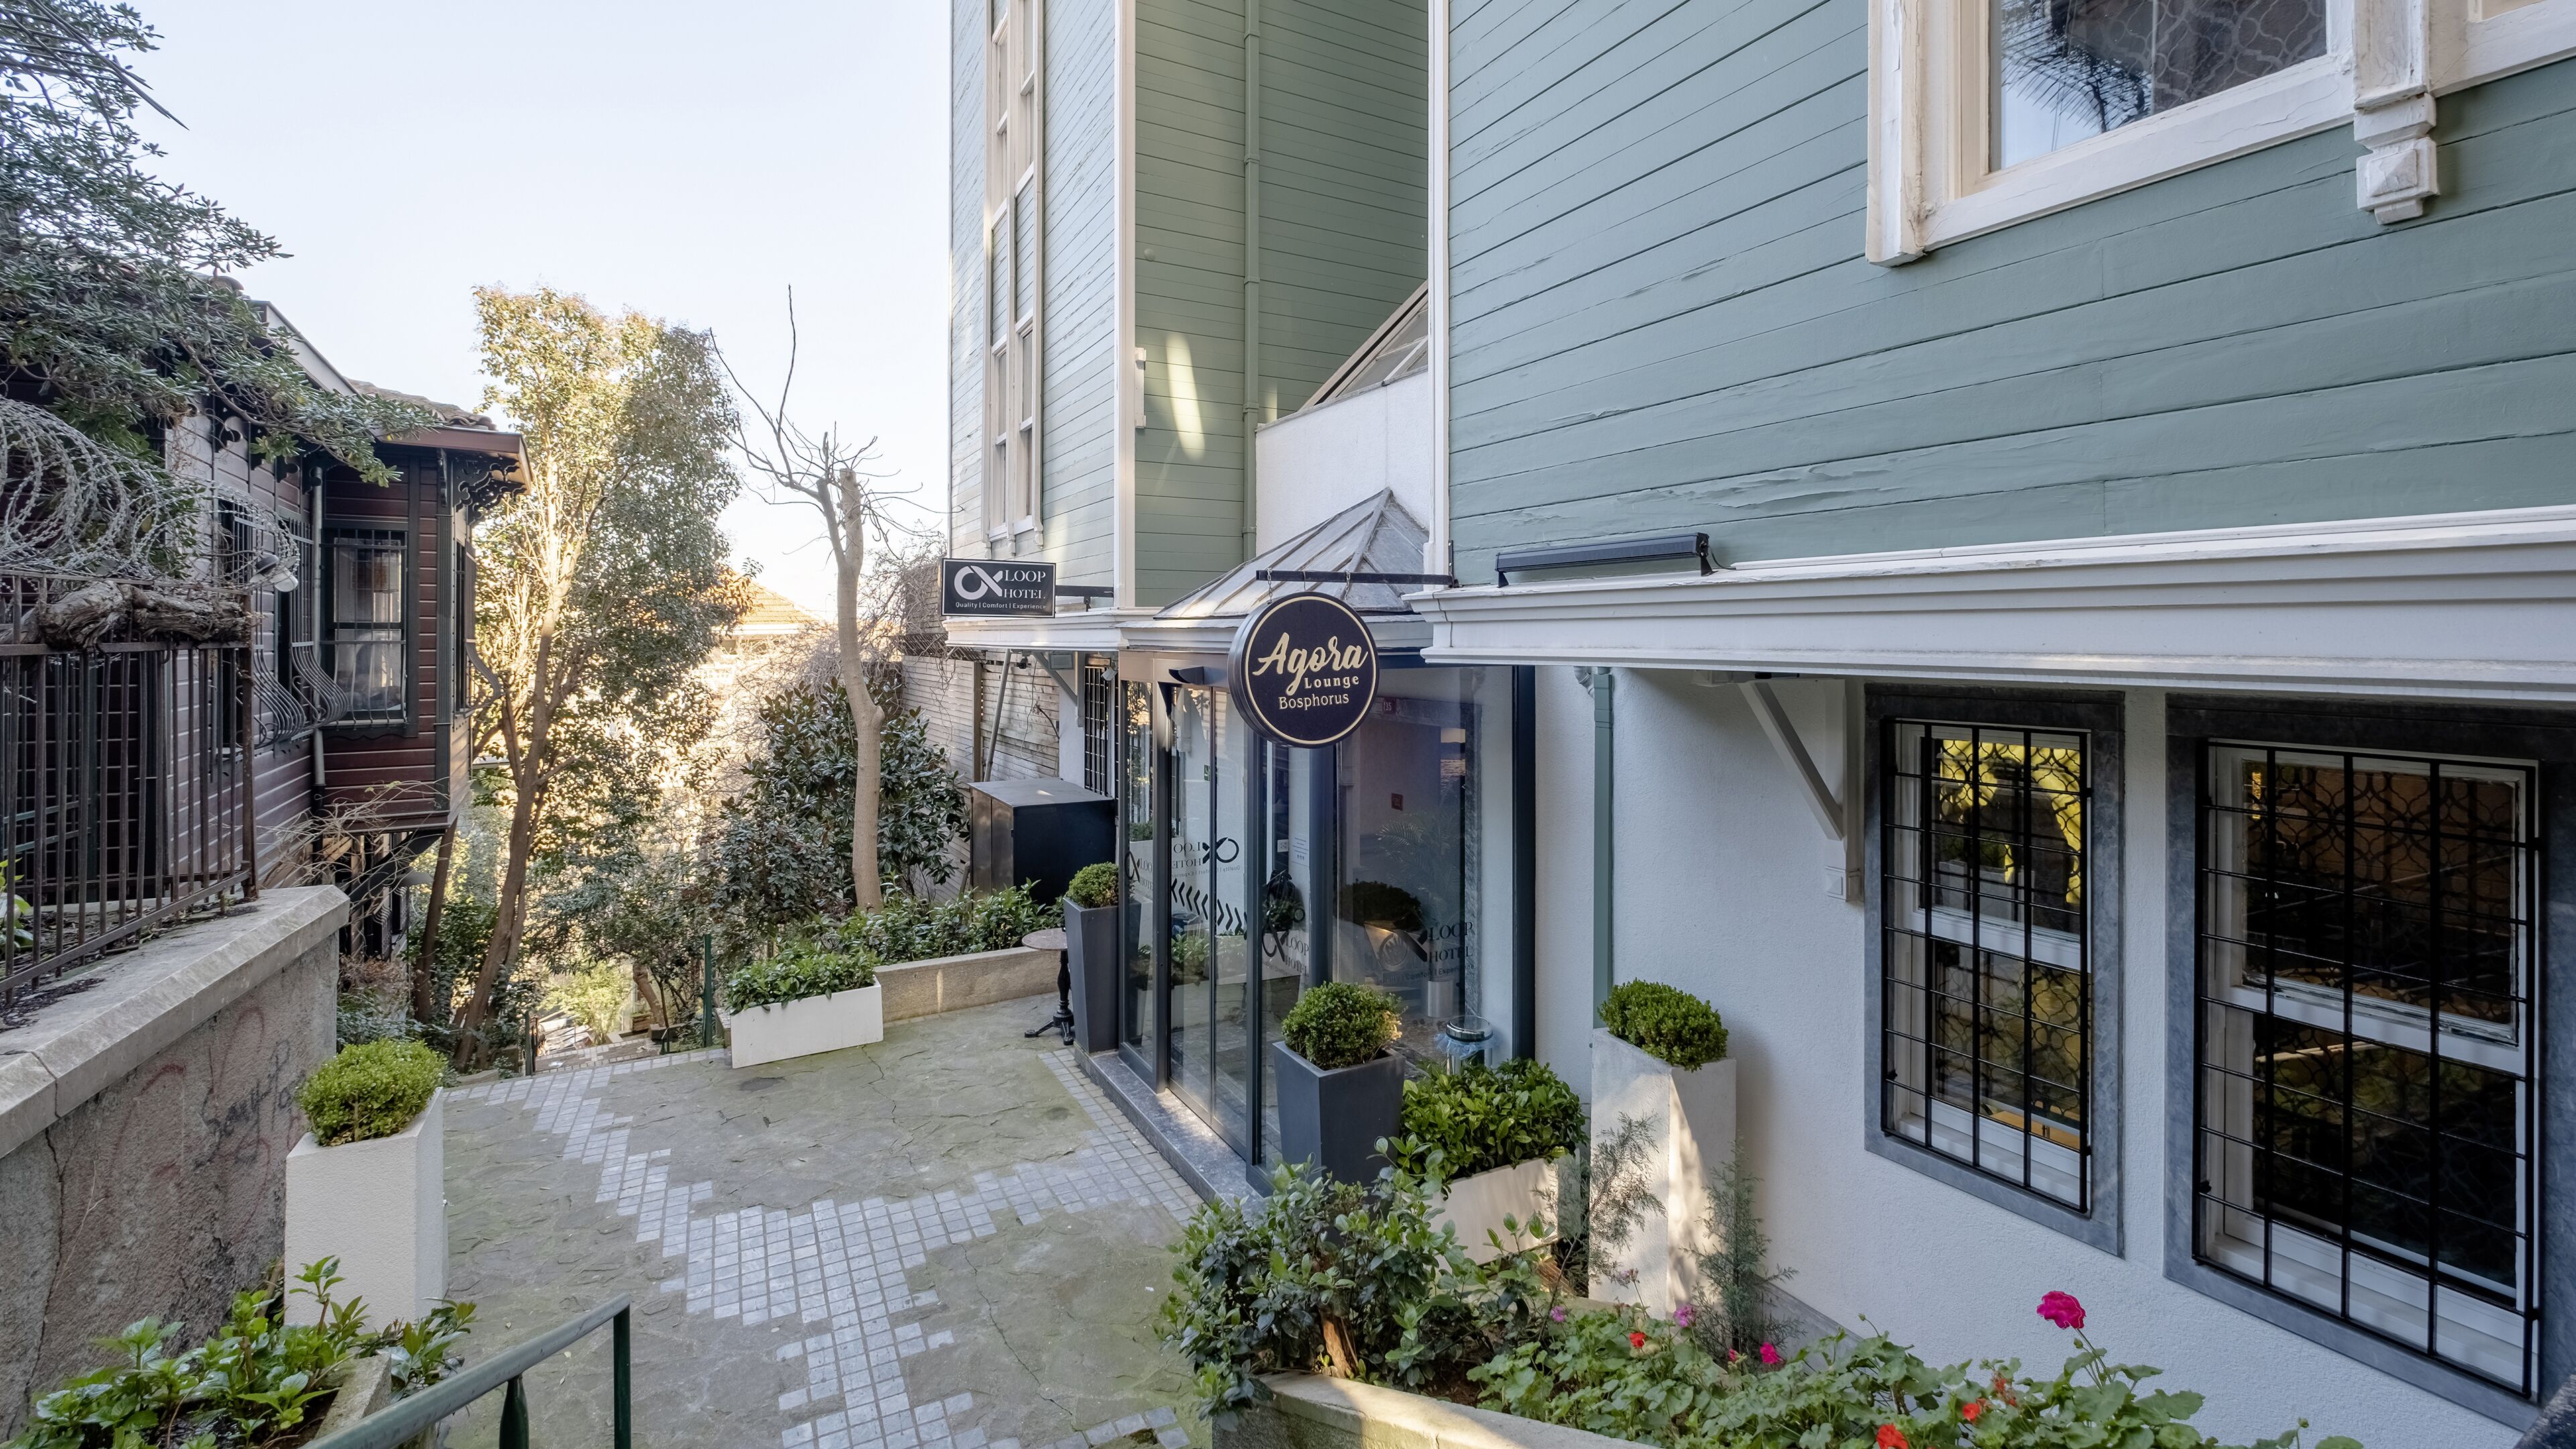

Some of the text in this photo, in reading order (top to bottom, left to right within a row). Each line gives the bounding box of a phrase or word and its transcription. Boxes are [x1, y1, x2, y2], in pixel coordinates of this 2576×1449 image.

[1004, 570, 1046, 582] LOOP
[1004, 588, 1046, 599] HOTEL
[1252, 632, 1368, 696] Agora
[1303, 675, 1360, 689] Lounge
[1278, 693, 1350, 710] Bosphorus
[1430, 922, 1473, 941] LOOP
